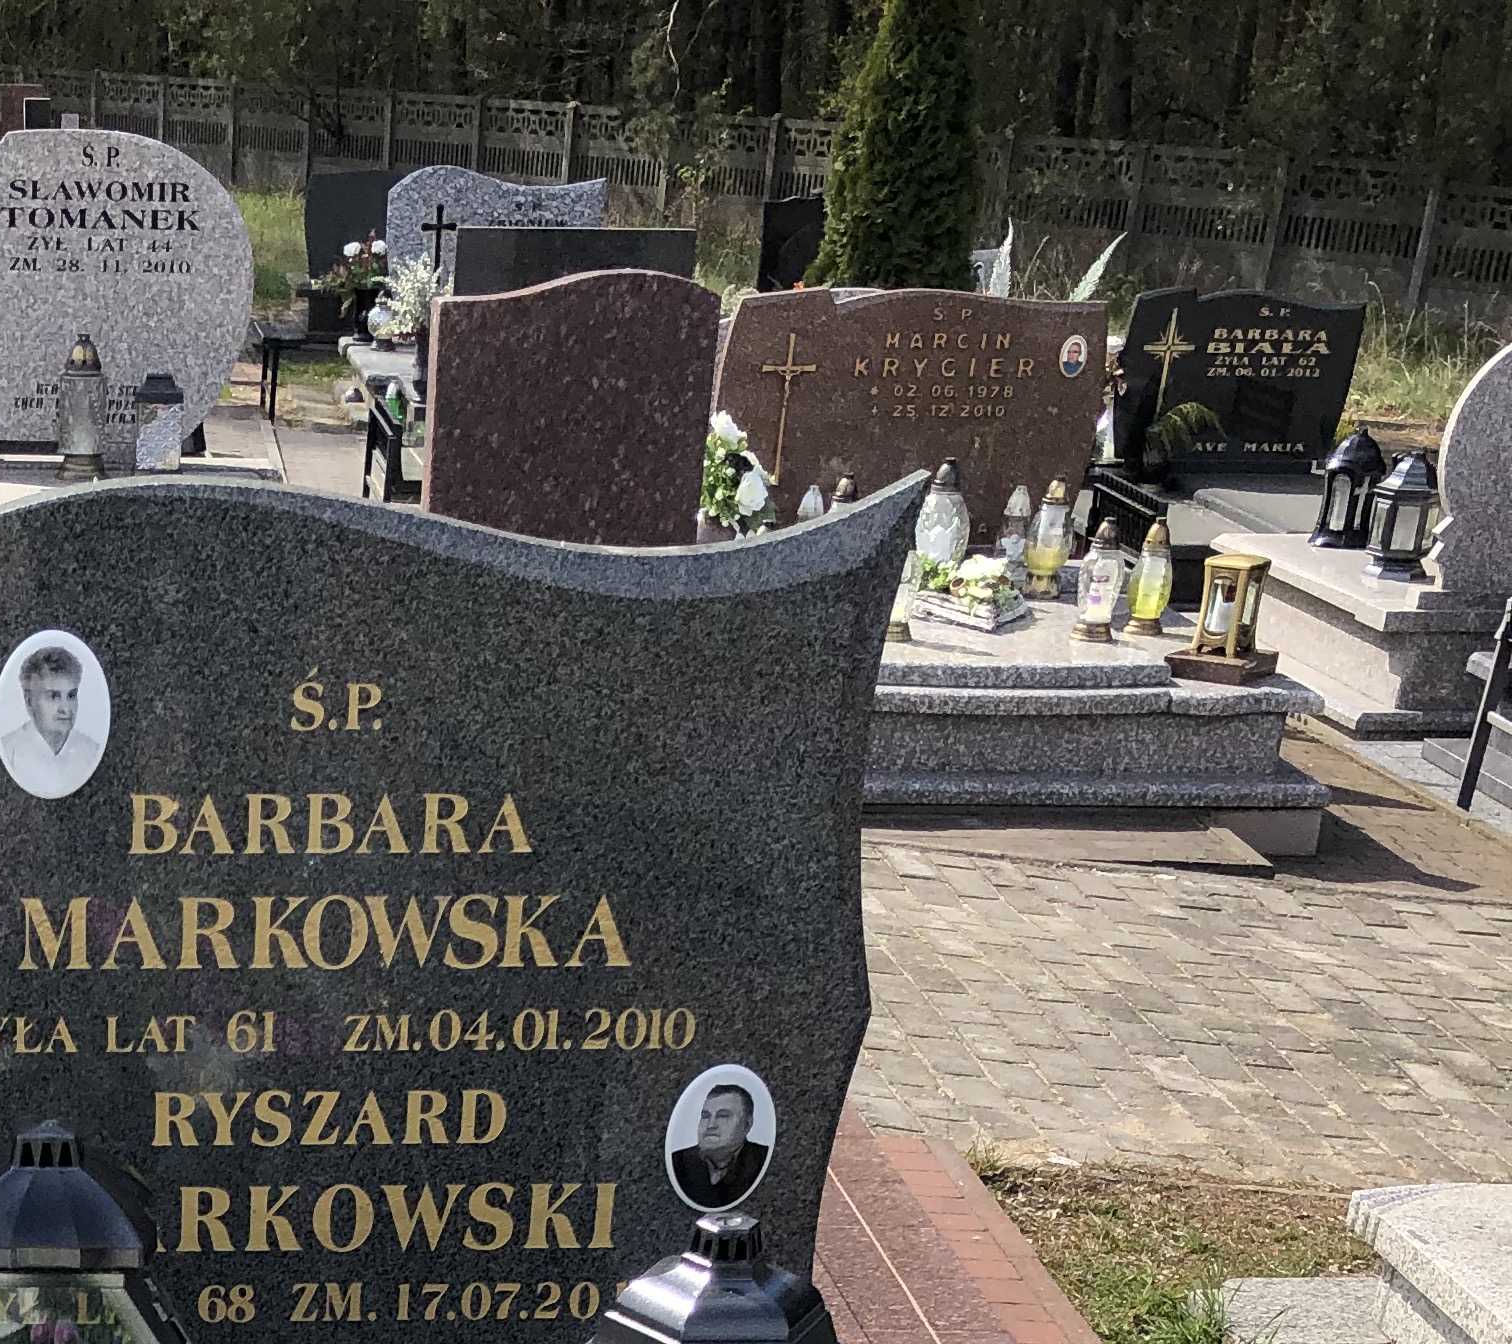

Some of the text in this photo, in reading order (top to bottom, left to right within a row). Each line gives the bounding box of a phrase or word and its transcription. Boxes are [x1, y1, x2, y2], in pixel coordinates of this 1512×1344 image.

[8, 178, 191, 203] SŁAWOMIR
[0, 206, 201, 232] TOMANEK
[87, 236, 129, 252] LAT
[142, 258, 192, 275] 2010
[885, 331, 1012, 350] MARCIN
[1213, 327, 1329, 342] BARBARA
[853, 357, 1036, 379] KRYGIER
[1261, 356, 1288, 366] LAT
[1297, 356, 1317, 366] 62
[968, 384, 1015, 399] 1978
[960, 403, 1006, 418] 2010
[1192, 442, 1306, 453] AVE MARIA
[290, 665, 383, 732] Ś.P.
[128, 792, 534, 856] BARBARA
[17, 893, 634, 972] MARKOWSKA
[105, 1015, 197, 1054] LAT
[226, 1009, 278, 1054] 61
[150, 1089, 508, 1147] RYSZARD
[155, 1181, 619, 1252] RKOWSKI
[197, 1283, 257, 1324] 68
[288, 1282, 378, 1323] ZM.
